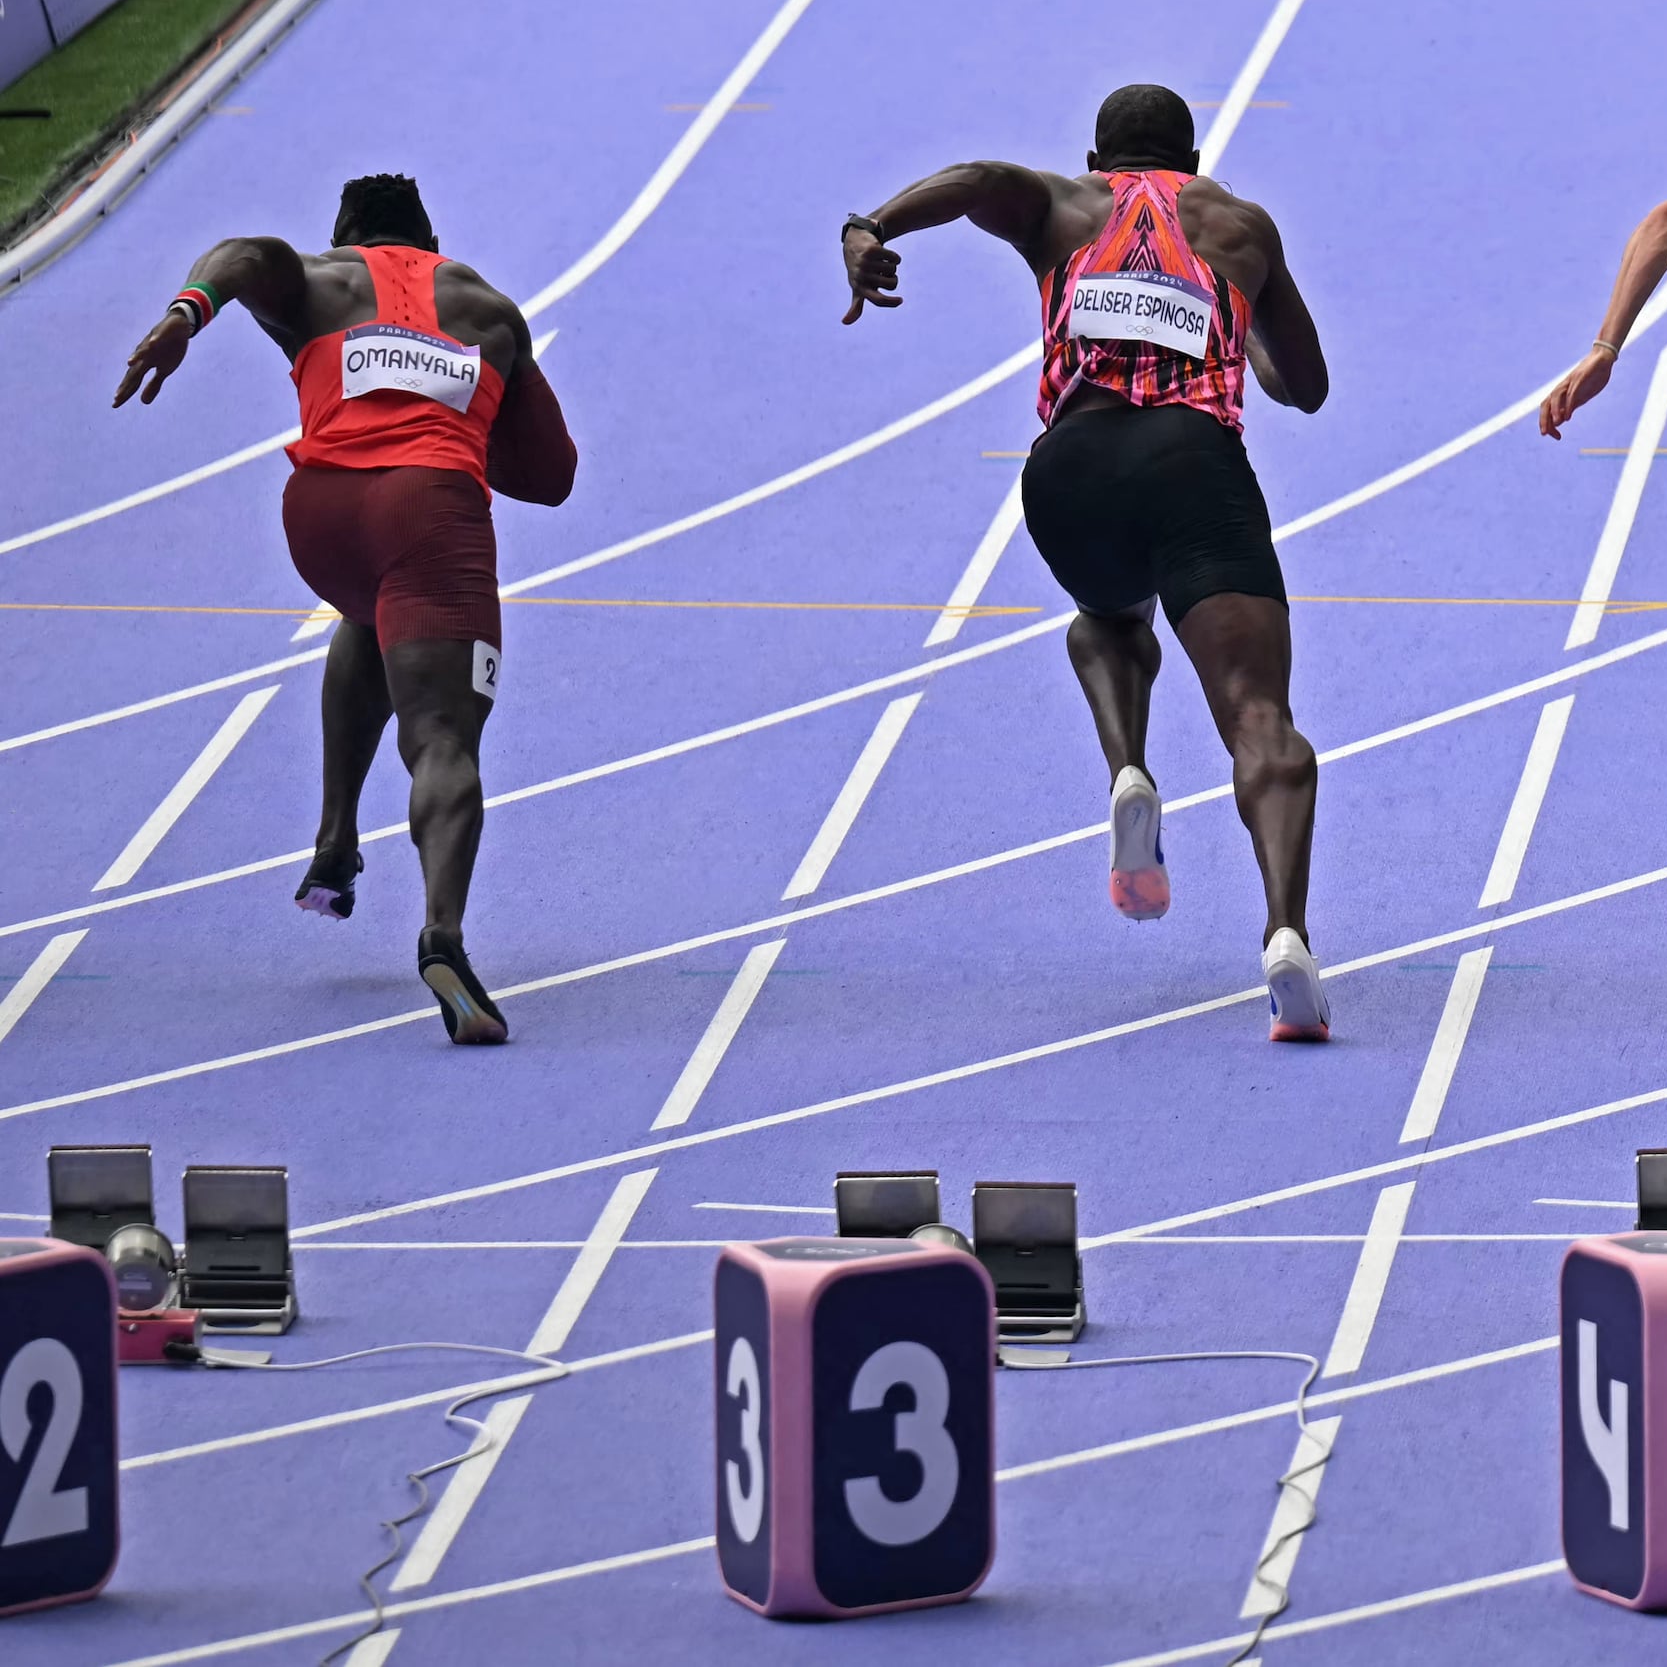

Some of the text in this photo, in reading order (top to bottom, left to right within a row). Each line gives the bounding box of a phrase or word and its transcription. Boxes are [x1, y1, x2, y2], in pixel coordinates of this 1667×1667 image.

[1153, 275, 1184, 287] 2024
[379, 326, 413, 337] PARIS
[1073, 288, 1205, 337] DELISER ESPINOSA
[347, 348, 475, 384] OMANYALA
[486, 657, 496, 687] 2
[0, 1337, 89, 1547] 2
[726, 1337, 764, 1544] 3
[843, 1340, 959, 1547] 3
[1578, 1318, 1629, 1532] 4
